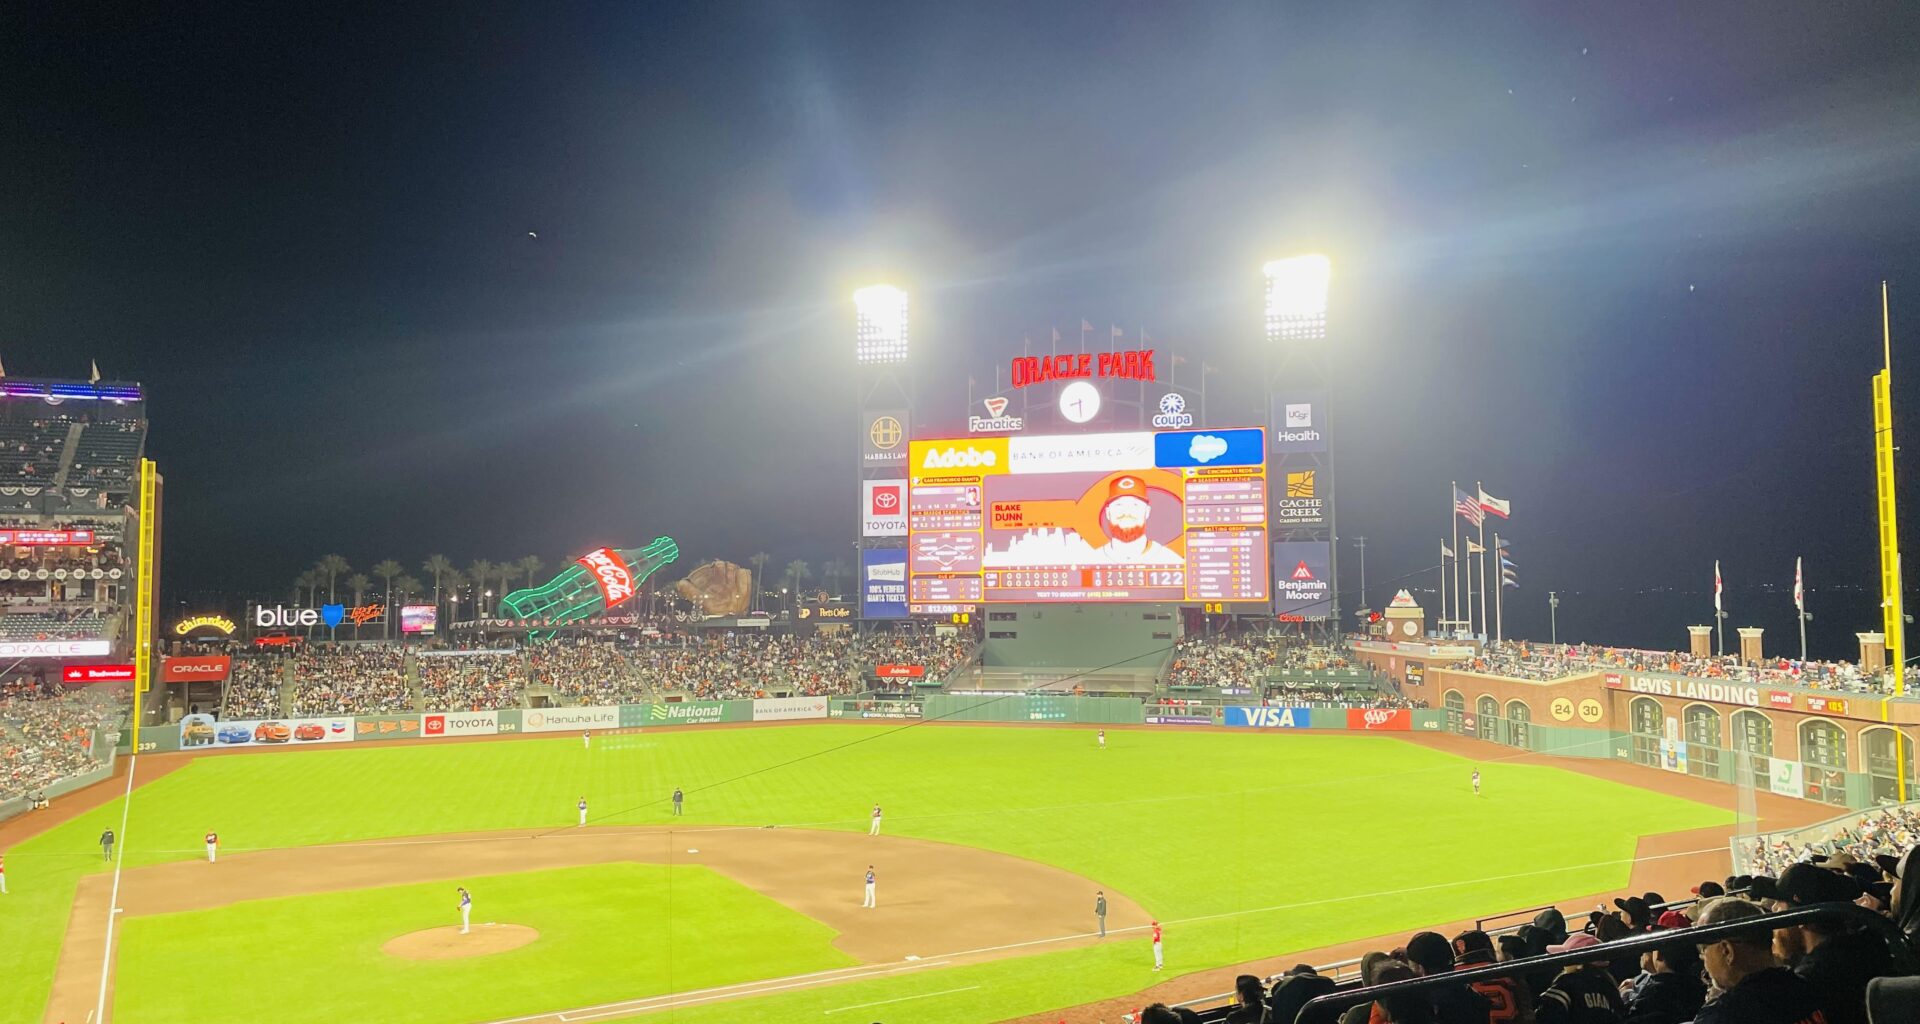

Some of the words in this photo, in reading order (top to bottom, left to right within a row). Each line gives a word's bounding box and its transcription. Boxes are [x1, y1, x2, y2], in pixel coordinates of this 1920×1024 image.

[1012, 354, 1092, 388] ORACLE
[1098, 350, 1156, 382] PARK
[1154, 414, 1190, 427] coupa
[1288, 410, 1308, 420] UCSF
[970, 416, 1022, 431] Fanatics
[1278, 430, 1320, 441] Health
[923, 447, 996, 468] Adobe
[1013, 452, 1044, 460] BANK
[1049, 451, 1062, 460] OF
[1067, 448, 1122, 458] AMERICA
[1280, 499, 1322, 507] CACHE
[1281, 508, 1321, 516] CREEK
[866, 522, 906, 530] TOYOTA
[1150, 572, 1157, 584] 1
[1161, 572, 1171, 584] 2
[1173, 572, 1183, 584] 2
[1278, 580, 1326, 591] Benjamin
[1286, 591, 1320, 599] Moore
[256, 604, 318, 627] blue
[834, 608, 850, 618] Coffee
[1280, 614, 1304, 622] Coors
[176, 614, 236, 634] Ghirardelli
[0, 644, 81, 654] ORACLE
[172, 665, 223, 673] ORACLE
[1677, 680, 1759, 706] LANDING
[668, 704, 723, 719] National
[1555, 704, 1570, 714] 24
[1583, 706, 1598, 716] 30
[546, 715, 591, 725] Hanwha
[594, 714, 614, 723] Life
[1241, 708, 1295, 727] VISA
[450, 718, 494, 729] TOYOTA
